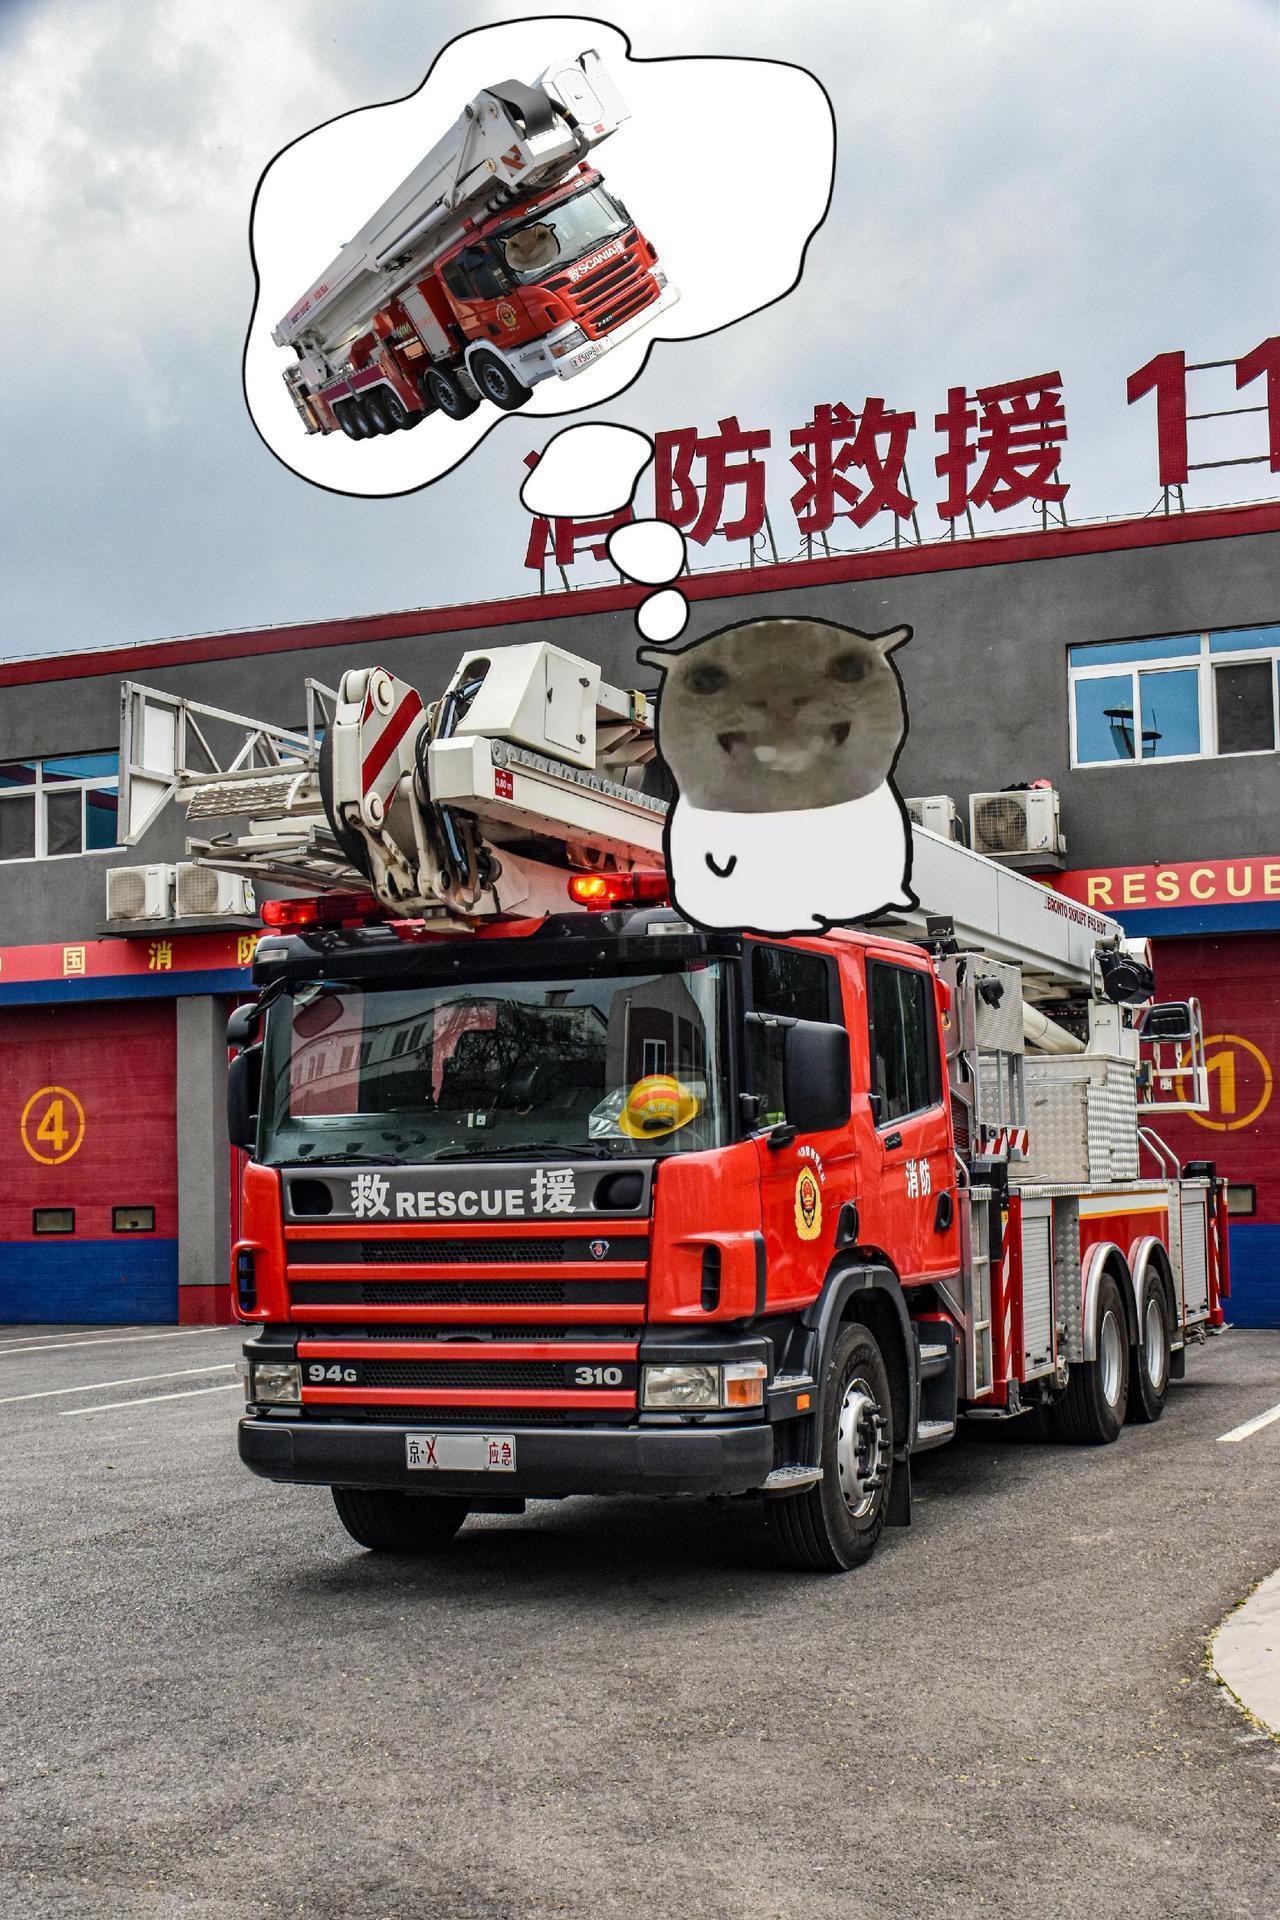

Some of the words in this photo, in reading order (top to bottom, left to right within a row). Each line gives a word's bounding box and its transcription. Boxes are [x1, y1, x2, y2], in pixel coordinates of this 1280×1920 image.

[1087, 864, 1280, 907] RESCUE
[1047, 896, 1068, 918] BRONTO
[1205, 1050, 1236, 1114] 1
[37, 1100, 69, 1150] 4
[351, 1174, 391, 1218] 救
[396, 1189, 525, 1218] RESCUE
[530, 1168, 577, 1214] 援
[905, 1157, 931, 1199] 消防
[308, 1364, 357, 1382] 94G
[574, 1366, 624, 1386] 310
